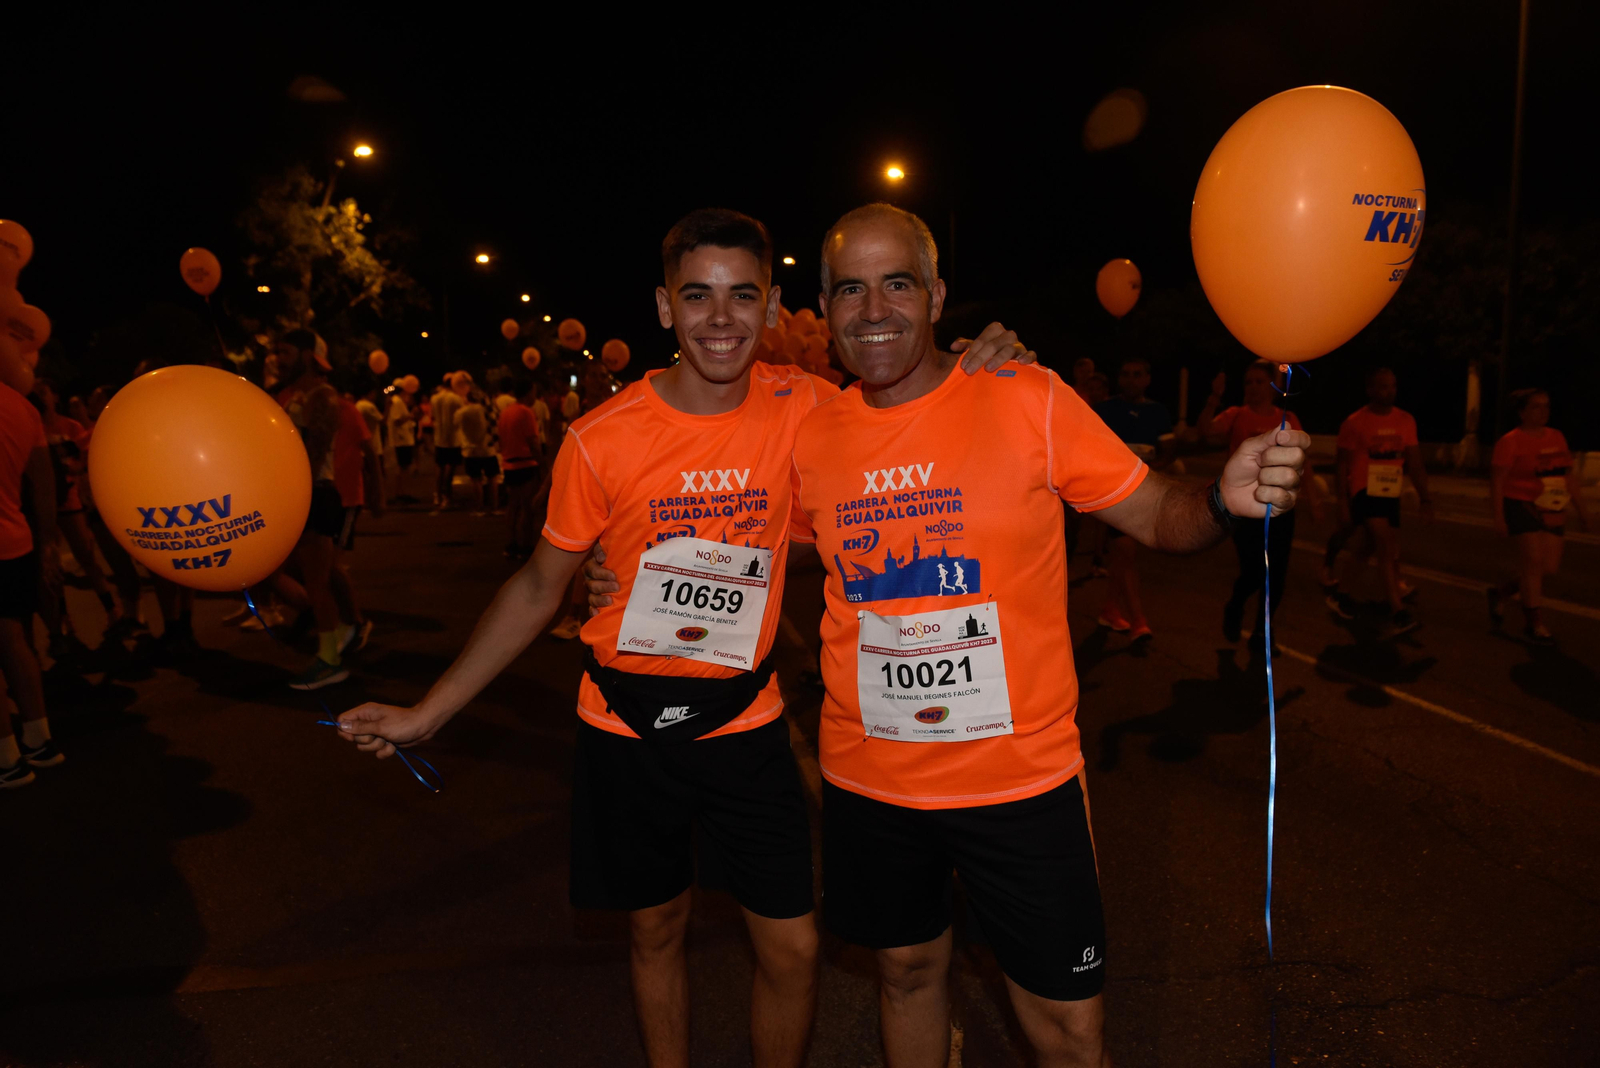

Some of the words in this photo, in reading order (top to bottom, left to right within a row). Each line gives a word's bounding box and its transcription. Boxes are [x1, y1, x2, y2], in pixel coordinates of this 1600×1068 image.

[1352, 193, 1418, 210] NOCTURNA
[680, 468, 751, 494] XXXV
[862, 462, 935, 495] XXXV
[649, 496, 707, 509] CARRERA
[711, 488, 768, 504] NOCTRNA
[836, 496, 888, 513] CARRERA
[893, 487, 963, 504] NOCTURNA
[137, 493, 232, 529] XXXV
[650, 509, 658, 523] DEL
[843, 500, 963, 526] GUADALQUIVIR
[126, 528, 183, 540] CARRERA
[184, 510, 263, 539] NOCTURNA
[136, 518, 267, 551] GUADALQUIVIR
[171, 548, 232, 570] KH-7
[660, 566, 682, 574] CARRERA
[682, 569, 706, 579] NOCTURNA
[661, 578, 744, 615] 10659
[652, 607, 668, 615] JOSÉ
[668, 610, 692, 620] RAMÓN
[692, 613, 716, 623] GARCÍA
[715, 617, 738, 627] BENITEZ
[713, 649, 747, 662] Cruzcampo
[892, 649, 920, 657] NOCTURNA
[930, 640, 970, 653] GUADALQUIVIR
[881, 655, 973, 690] 10021
[924, 691, 953, 700] BEGINES
[953, 687, 981, 698] FALCÓN
[660, 706, 690, 720] NIKE
[966, 721, 1005, 734] Cruzcampo
[1072, 965, 1089, 973] TEAM
